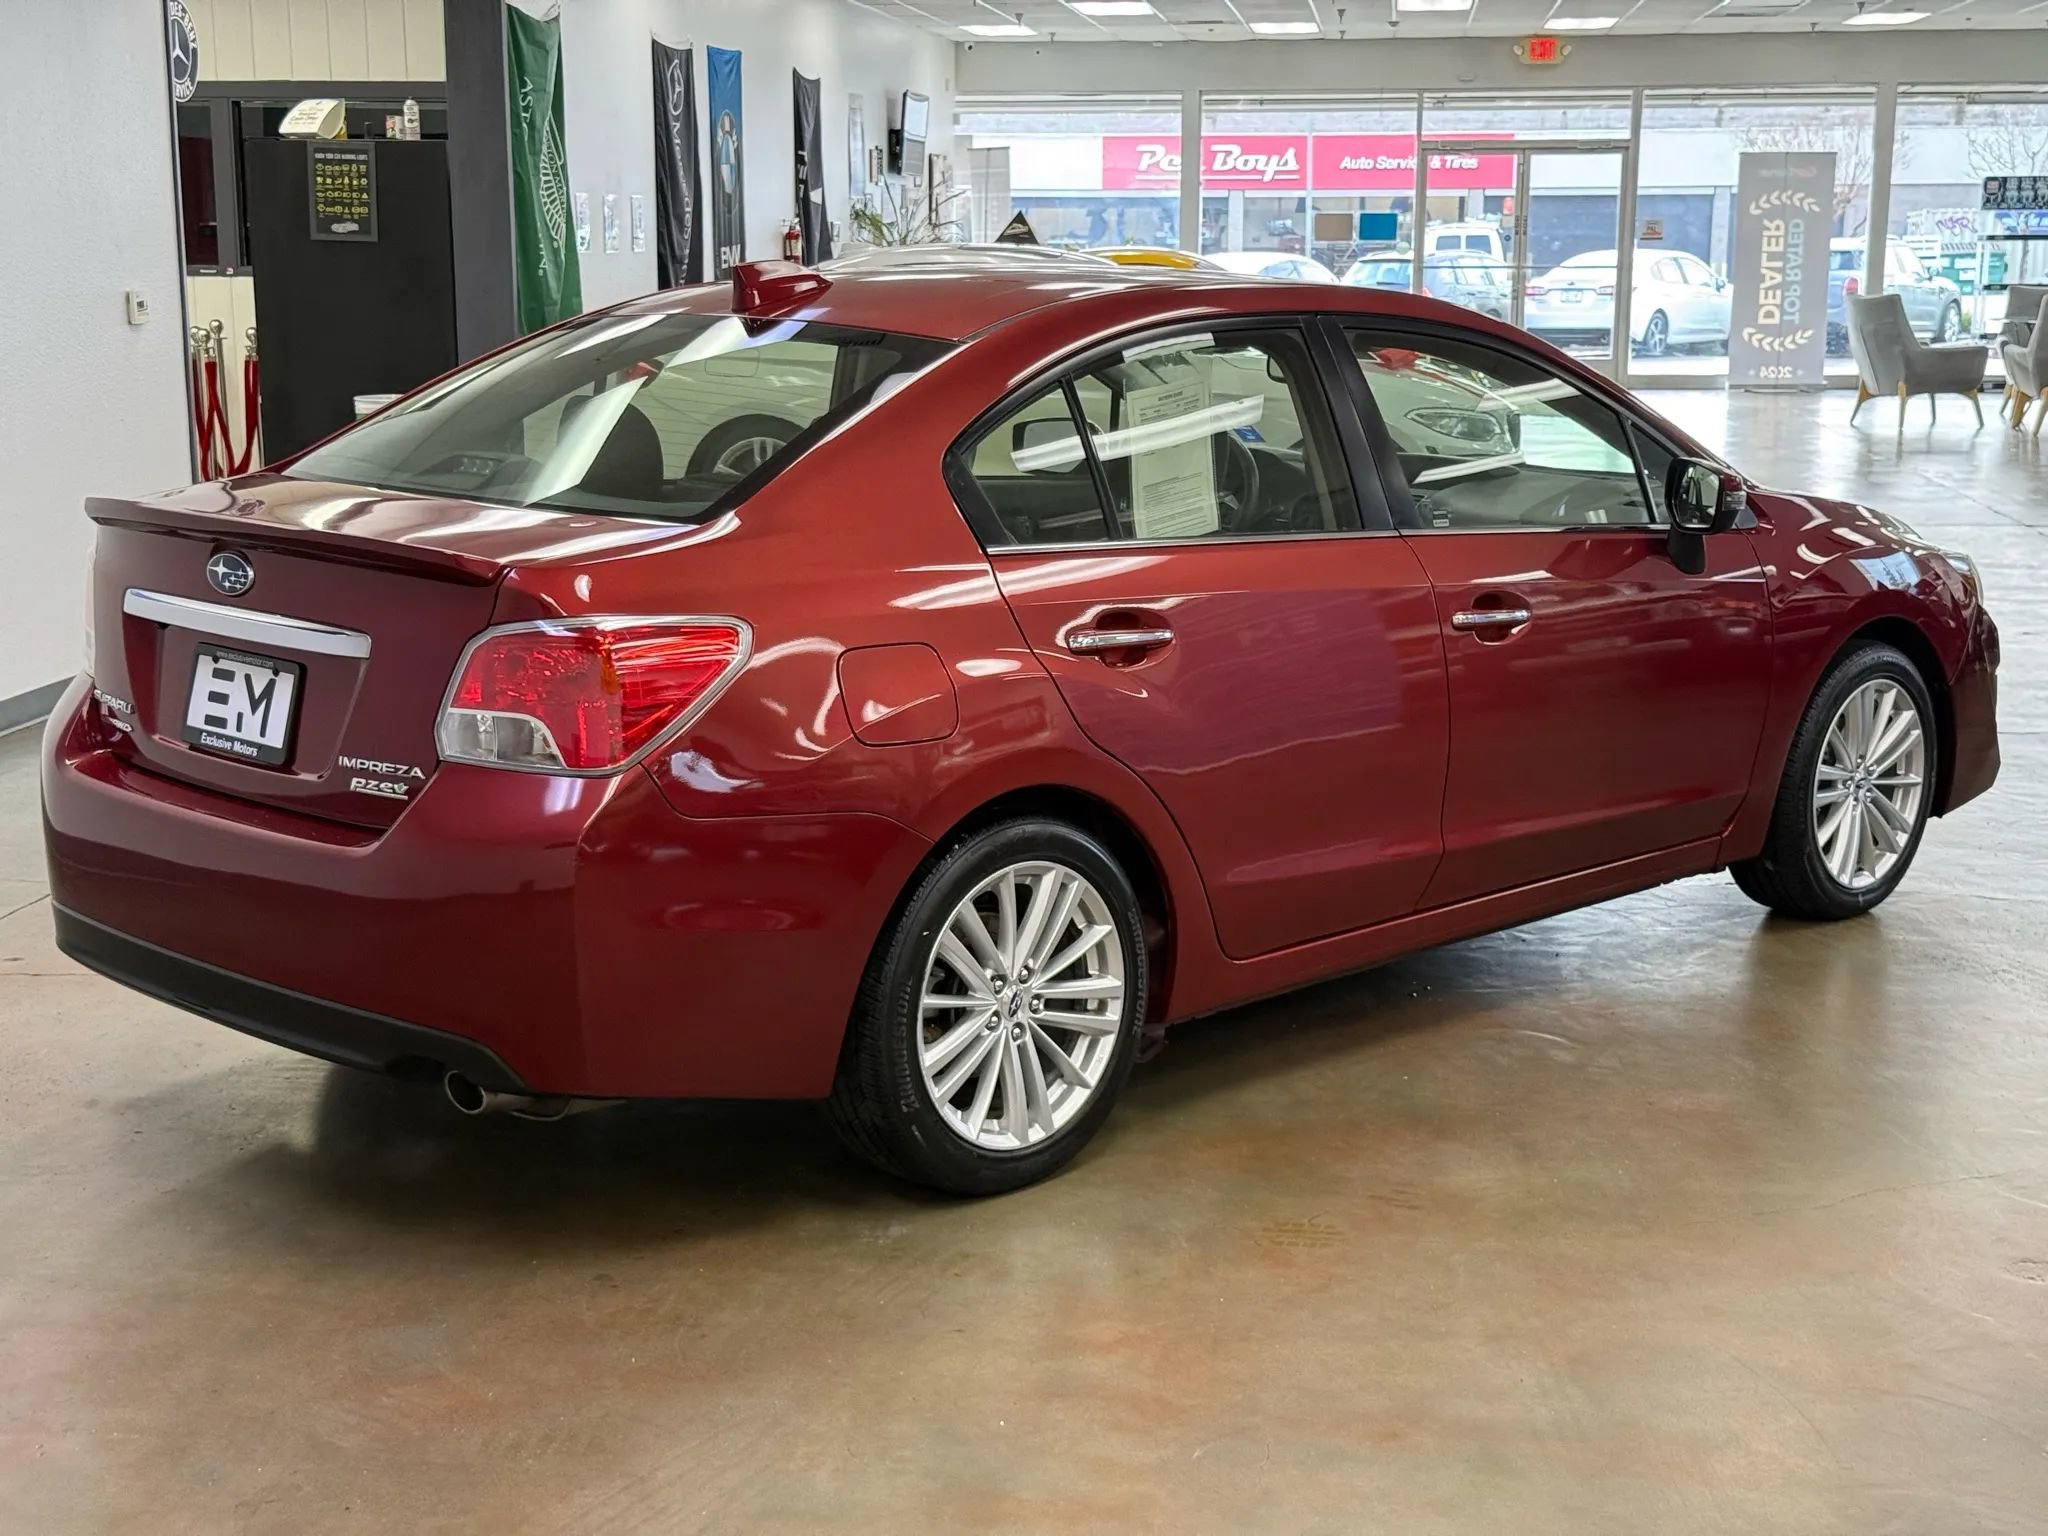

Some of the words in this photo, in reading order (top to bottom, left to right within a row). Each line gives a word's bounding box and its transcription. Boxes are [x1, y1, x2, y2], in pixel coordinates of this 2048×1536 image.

[170, 1, 198, 49] DES-BENZ
[1136, 144, 1204, 171] Pe
[1210, 144, 1300, 183] Boys
[1339, 156, 1375, 170] Auto
[1376, 156, 1417, 170] Servic
[1430, 156, 1442, 170] &
[1443, 156, 1478, 169] Tires
[200, 732, 233, 750] Exclusive
[232, 741, 259, 757] Motors
[339, 755, 427, 779] IMPREZA
